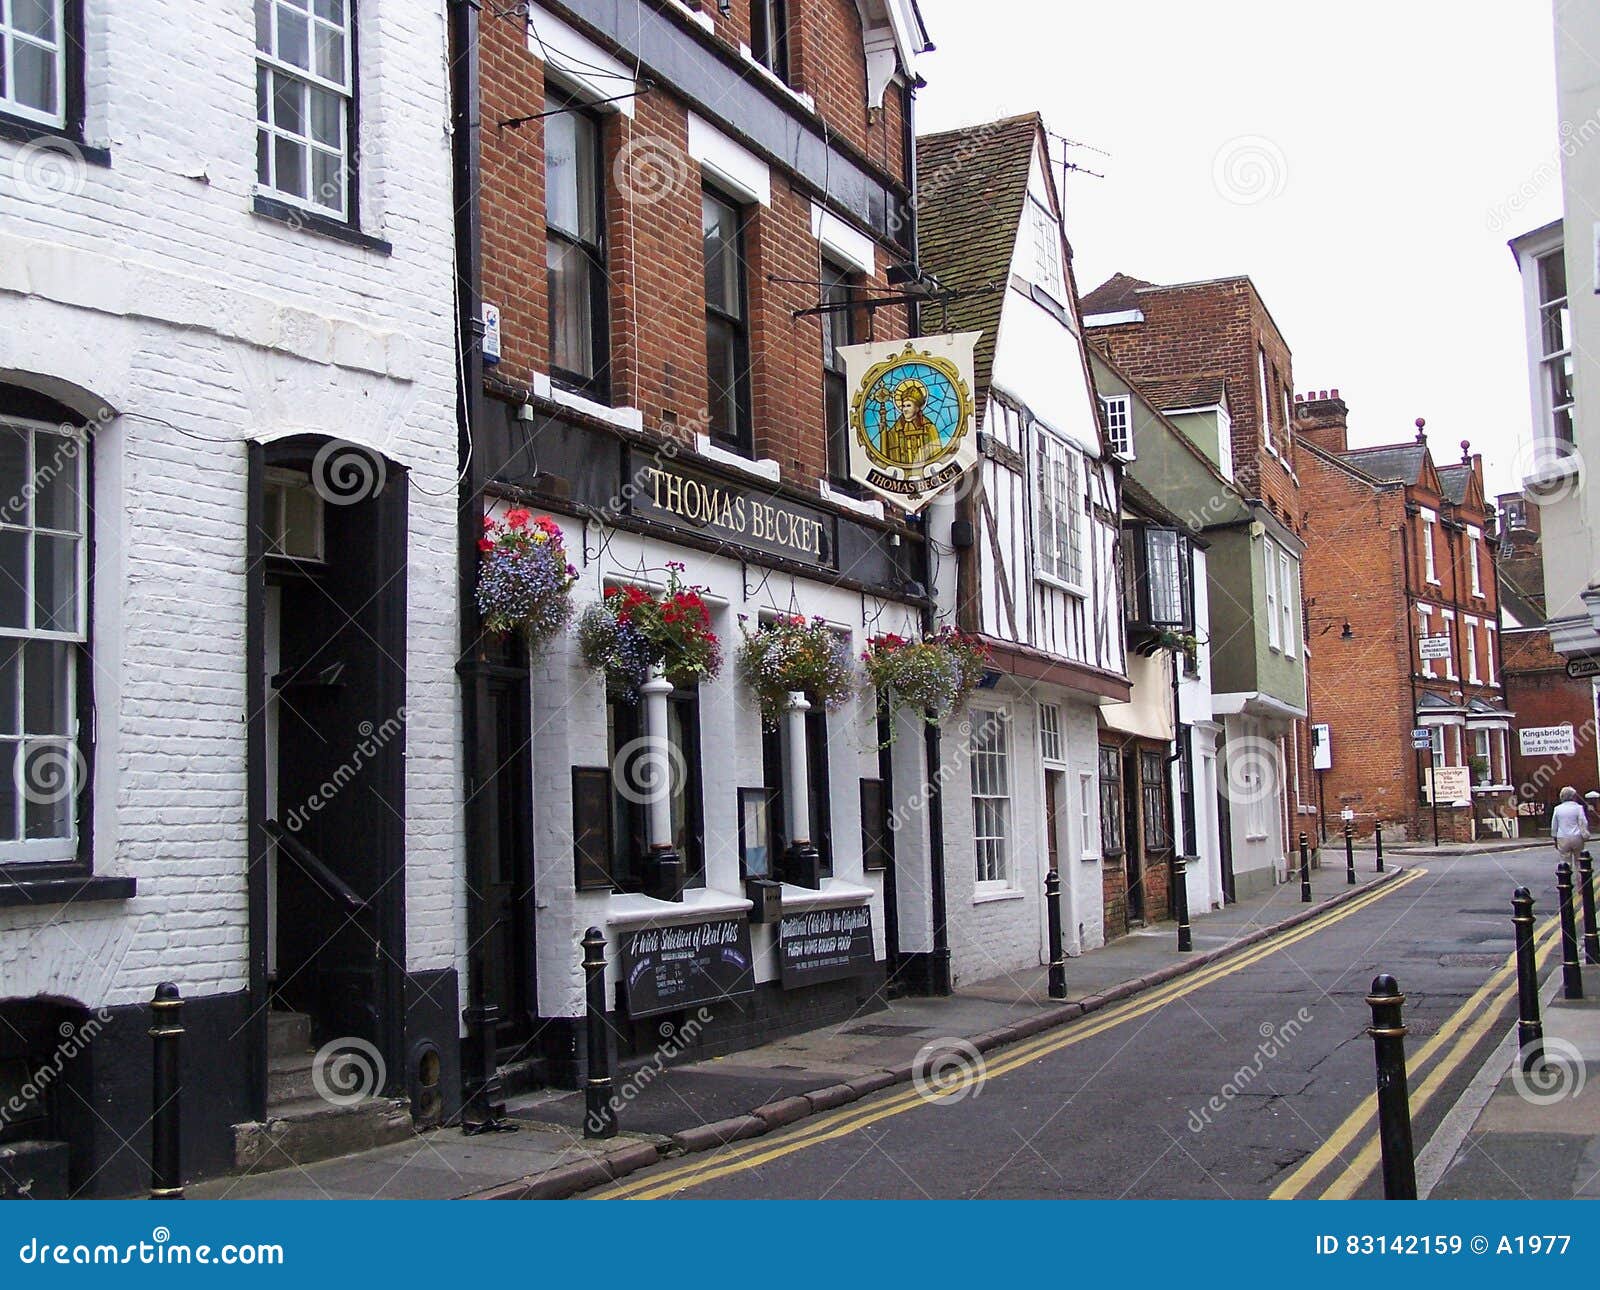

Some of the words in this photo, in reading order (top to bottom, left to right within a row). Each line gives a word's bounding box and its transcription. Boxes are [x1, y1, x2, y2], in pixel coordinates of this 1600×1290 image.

[871, 471, 915, 493] THOMAS
[917, 464, 959, 491] BECKET
[649, 467, 746, 533] THOMAS
[750, 501, 823, 555] BECKET
[1522, 728, 1570, 738] Kingsbridge
[660, 927, 692, 951] Selection
[837, 935, 852, 951] FOOD
